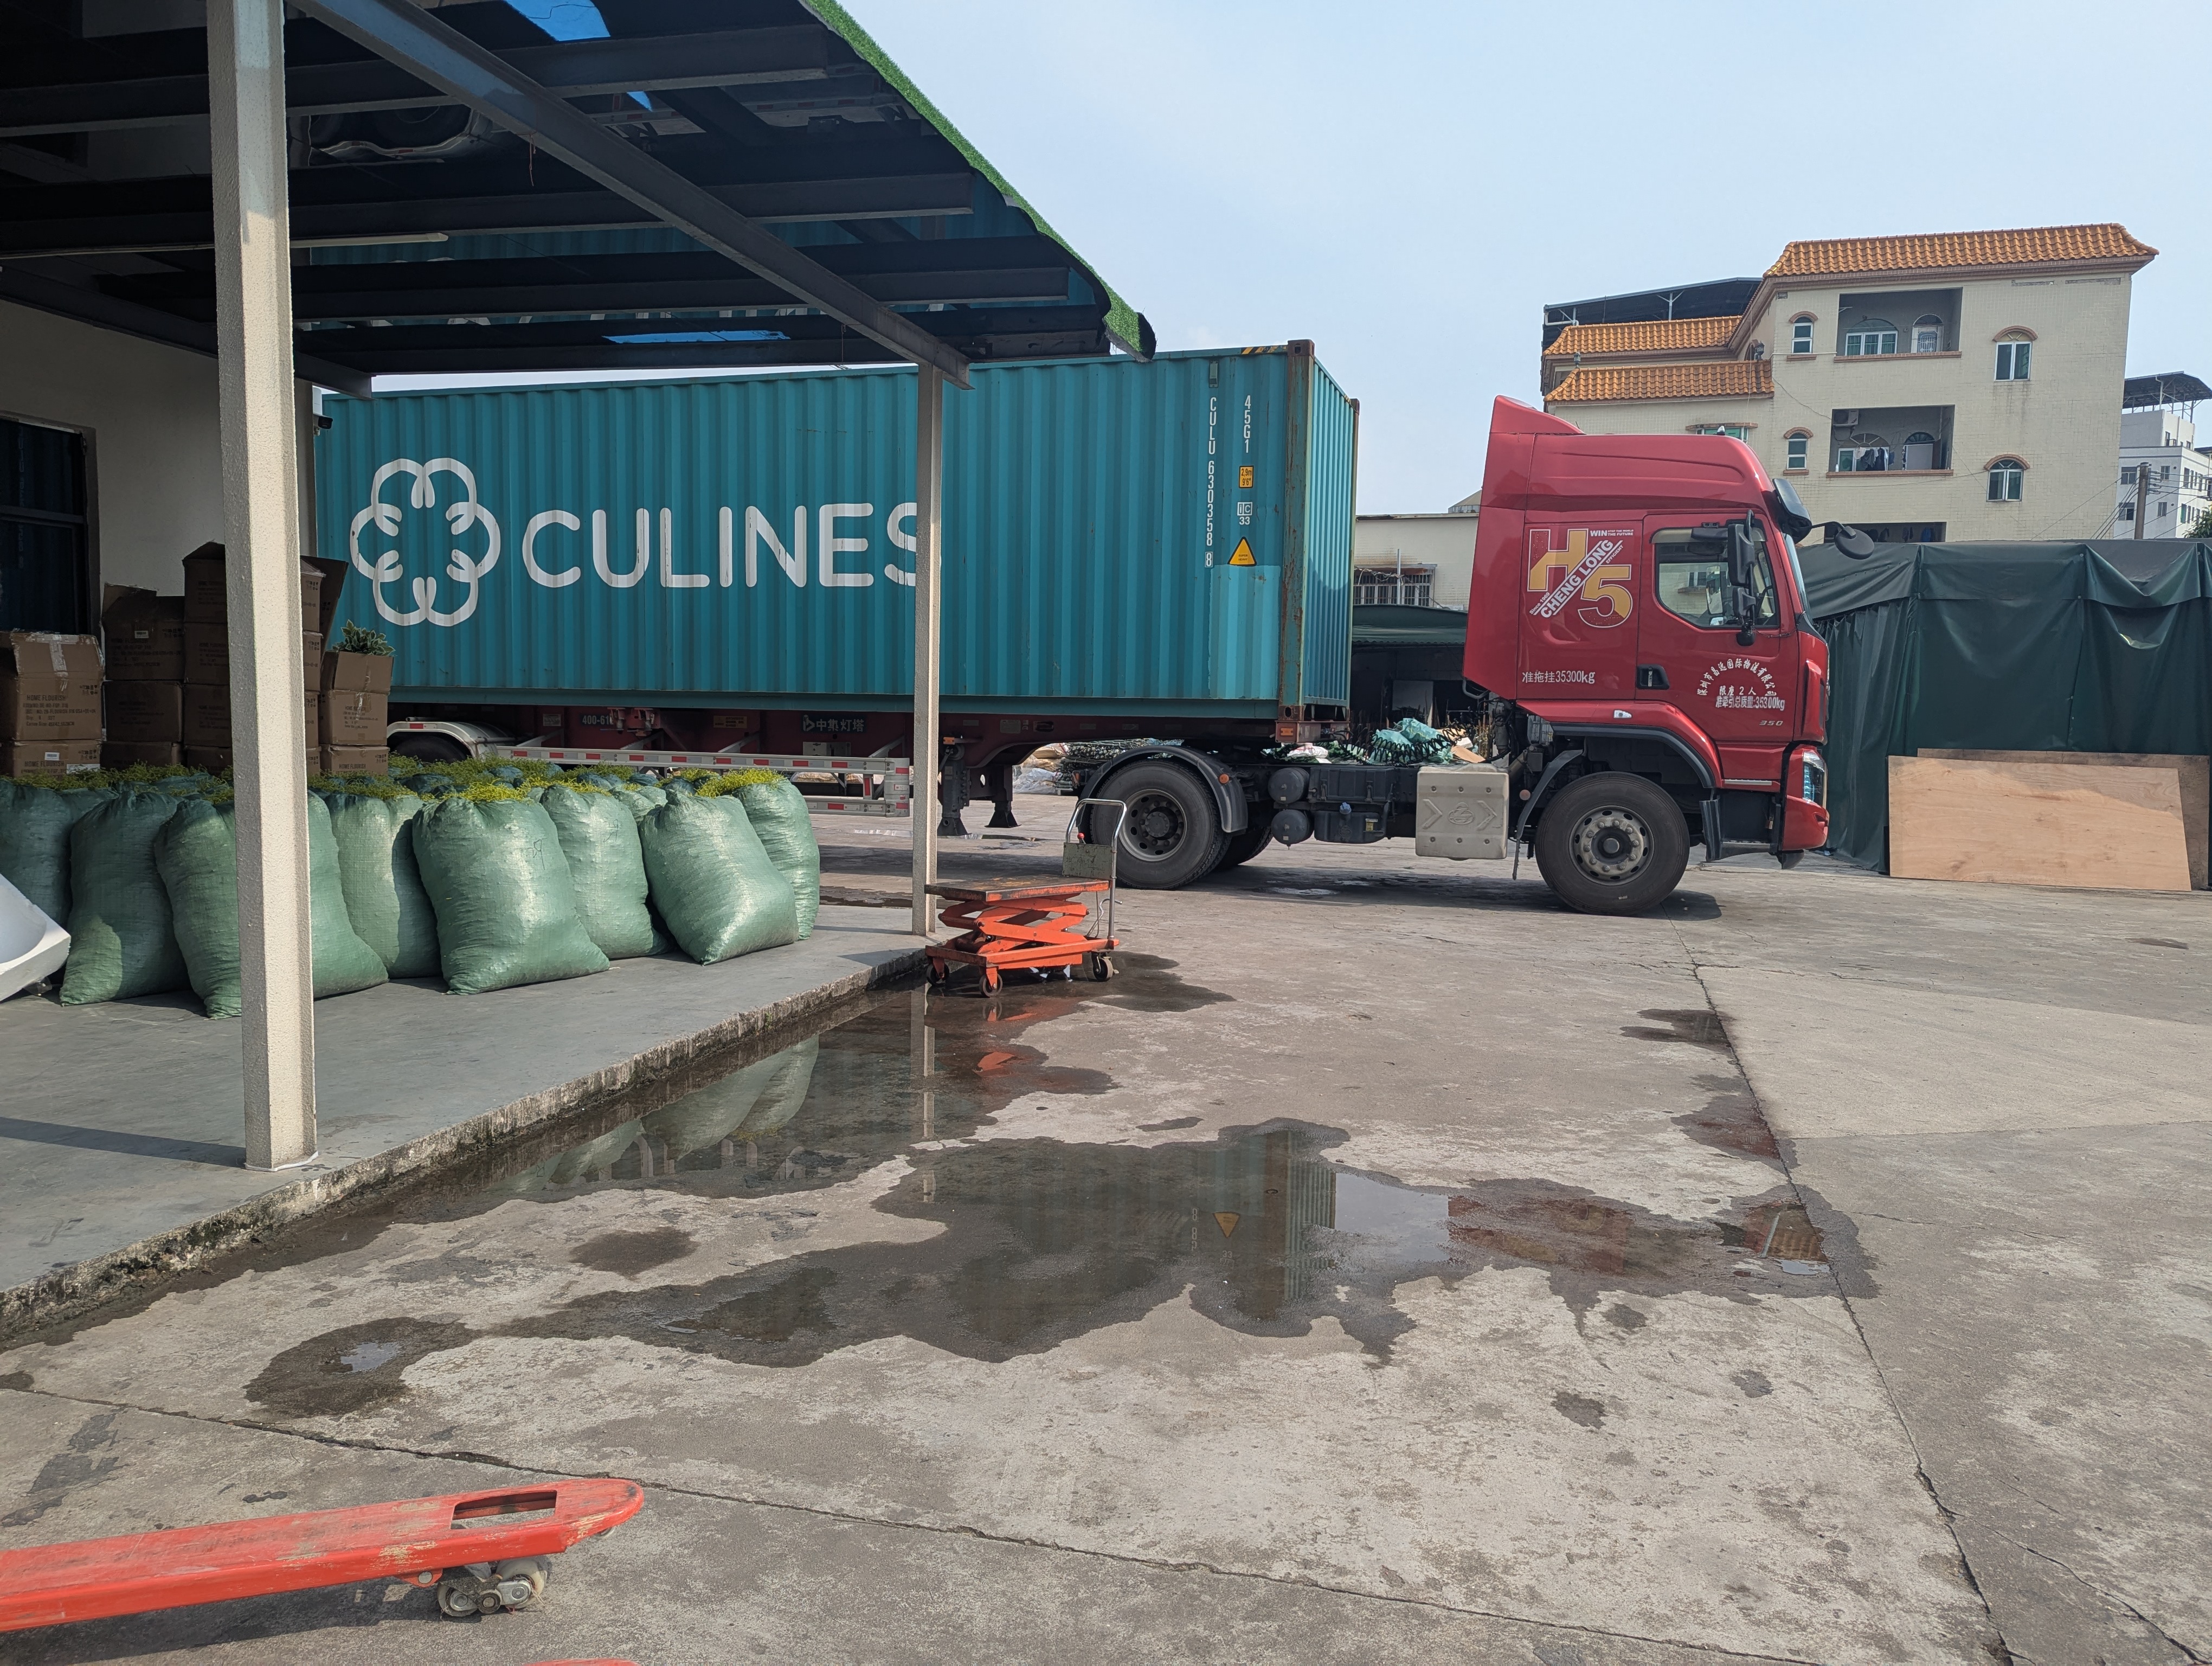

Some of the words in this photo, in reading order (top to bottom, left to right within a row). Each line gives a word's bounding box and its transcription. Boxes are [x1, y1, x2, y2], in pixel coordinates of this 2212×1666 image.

[1208, 396, 1217, 454] CULU
[1243, 395, 1251, 453] 45G1
[1206, 460, 1214, 546] 630358
[1239, 516, 1250, 525] 33
[1206, 553, 1212, 567] 8
[1605, 544, 1624, 564] EFFICIENT
[1541, 575, 1581, 618] CHENG
[1579, 540, 1613, 575] LONG
[1529, 603, 1541, 614] Since
[1522, 670, 1596, 684] 准拖挂35300kg
[582, 714, 611, 725] 400-61
[816, 718, 865, 732] 中集灯塔
